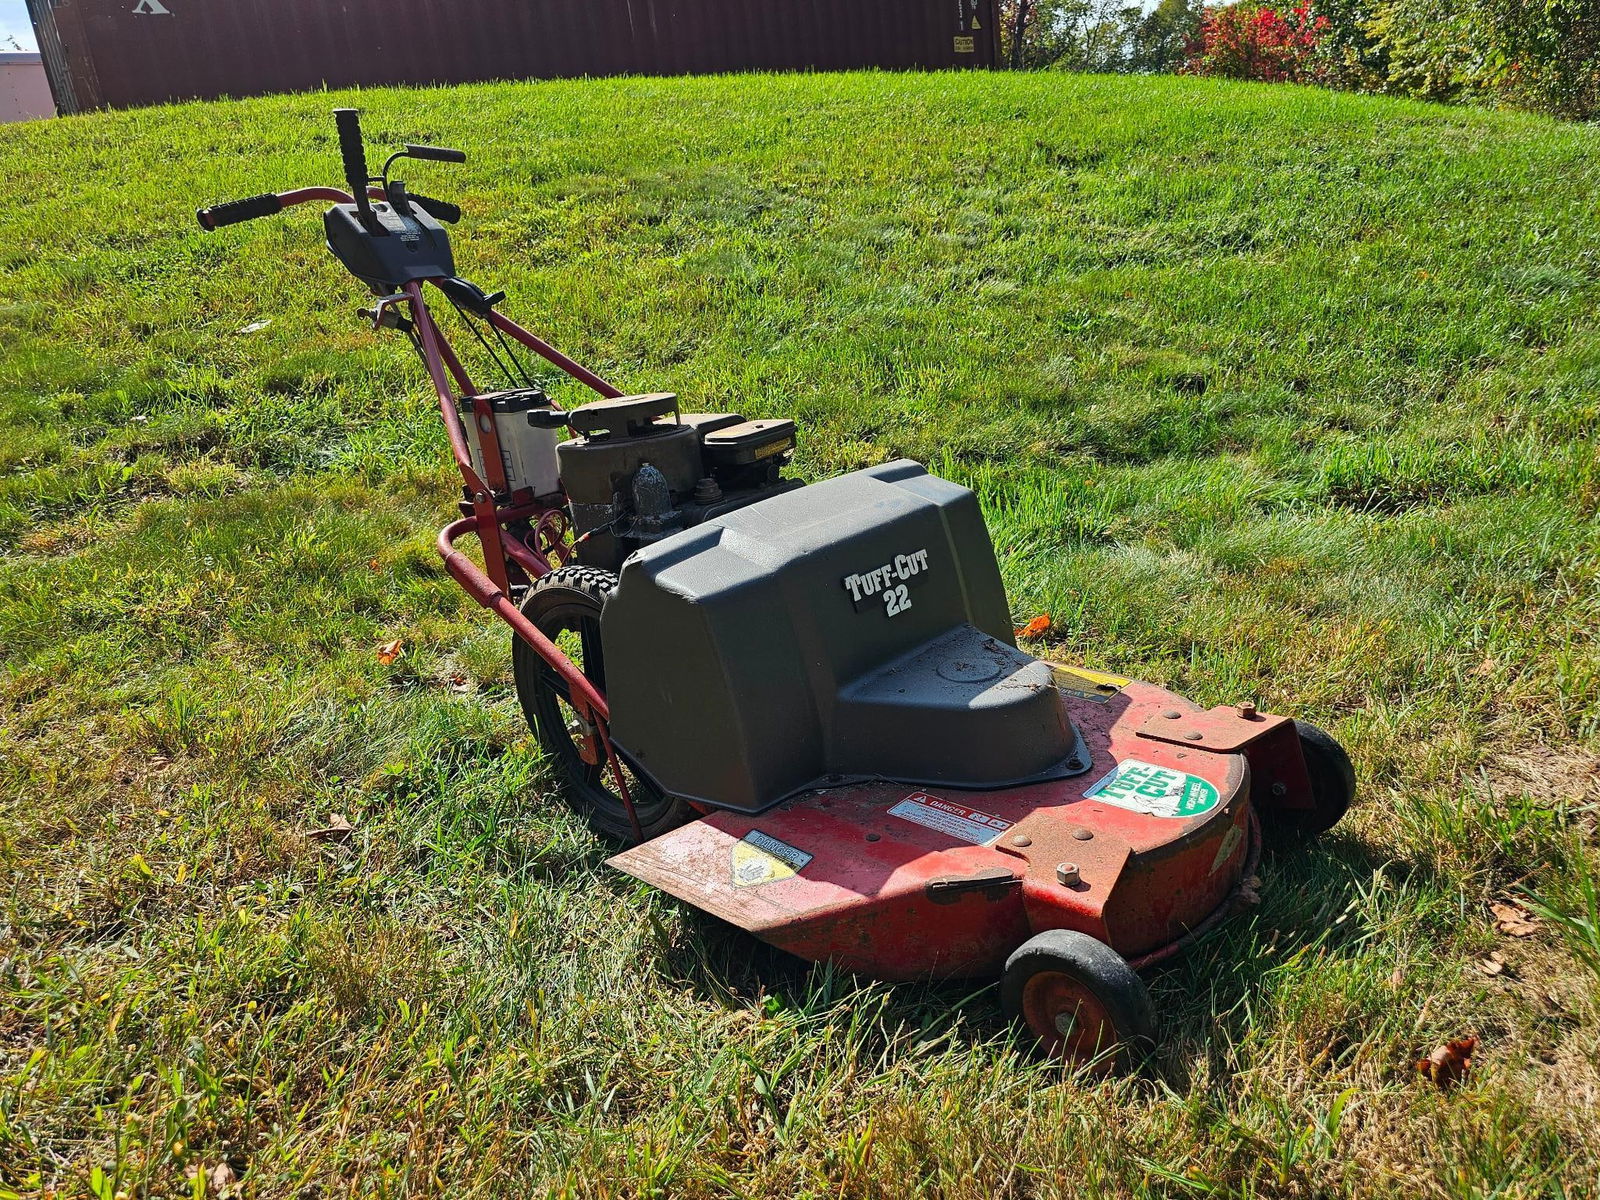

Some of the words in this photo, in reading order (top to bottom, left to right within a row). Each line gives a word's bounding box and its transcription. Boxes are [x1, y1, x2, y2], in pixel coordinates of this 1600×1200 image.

[844, 548, 929, 602] TUFF-CUT
[883, 584, 912, 617] 22
[1135, 770, 1177, 798] CUT
[929, 800, 966, 816] DANGER
[754, 836, 799, 860] DANGER
